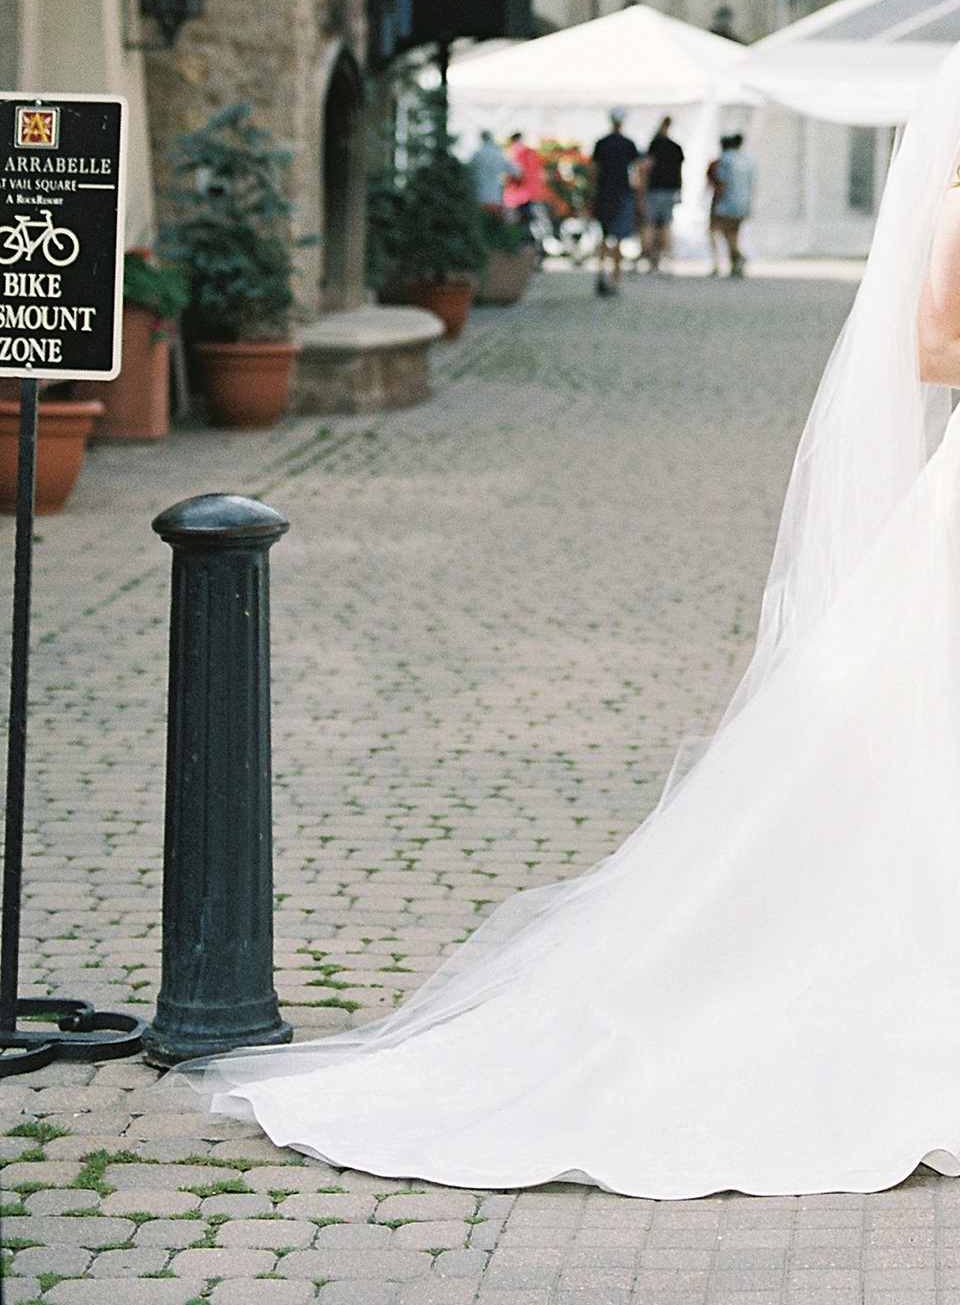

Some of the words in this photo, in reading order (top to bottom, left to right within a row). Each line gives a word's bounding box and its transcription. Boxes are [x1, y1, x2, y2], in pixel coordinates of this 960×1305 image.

[4, 156, 111, 174] ARRABELLE
[9, 178, 32, 190] VAIL
[35, 178, 77, 193] SQUARE
[3, 272, 62, 298] BIKE
[0, 336, 63, 363] ZONE
